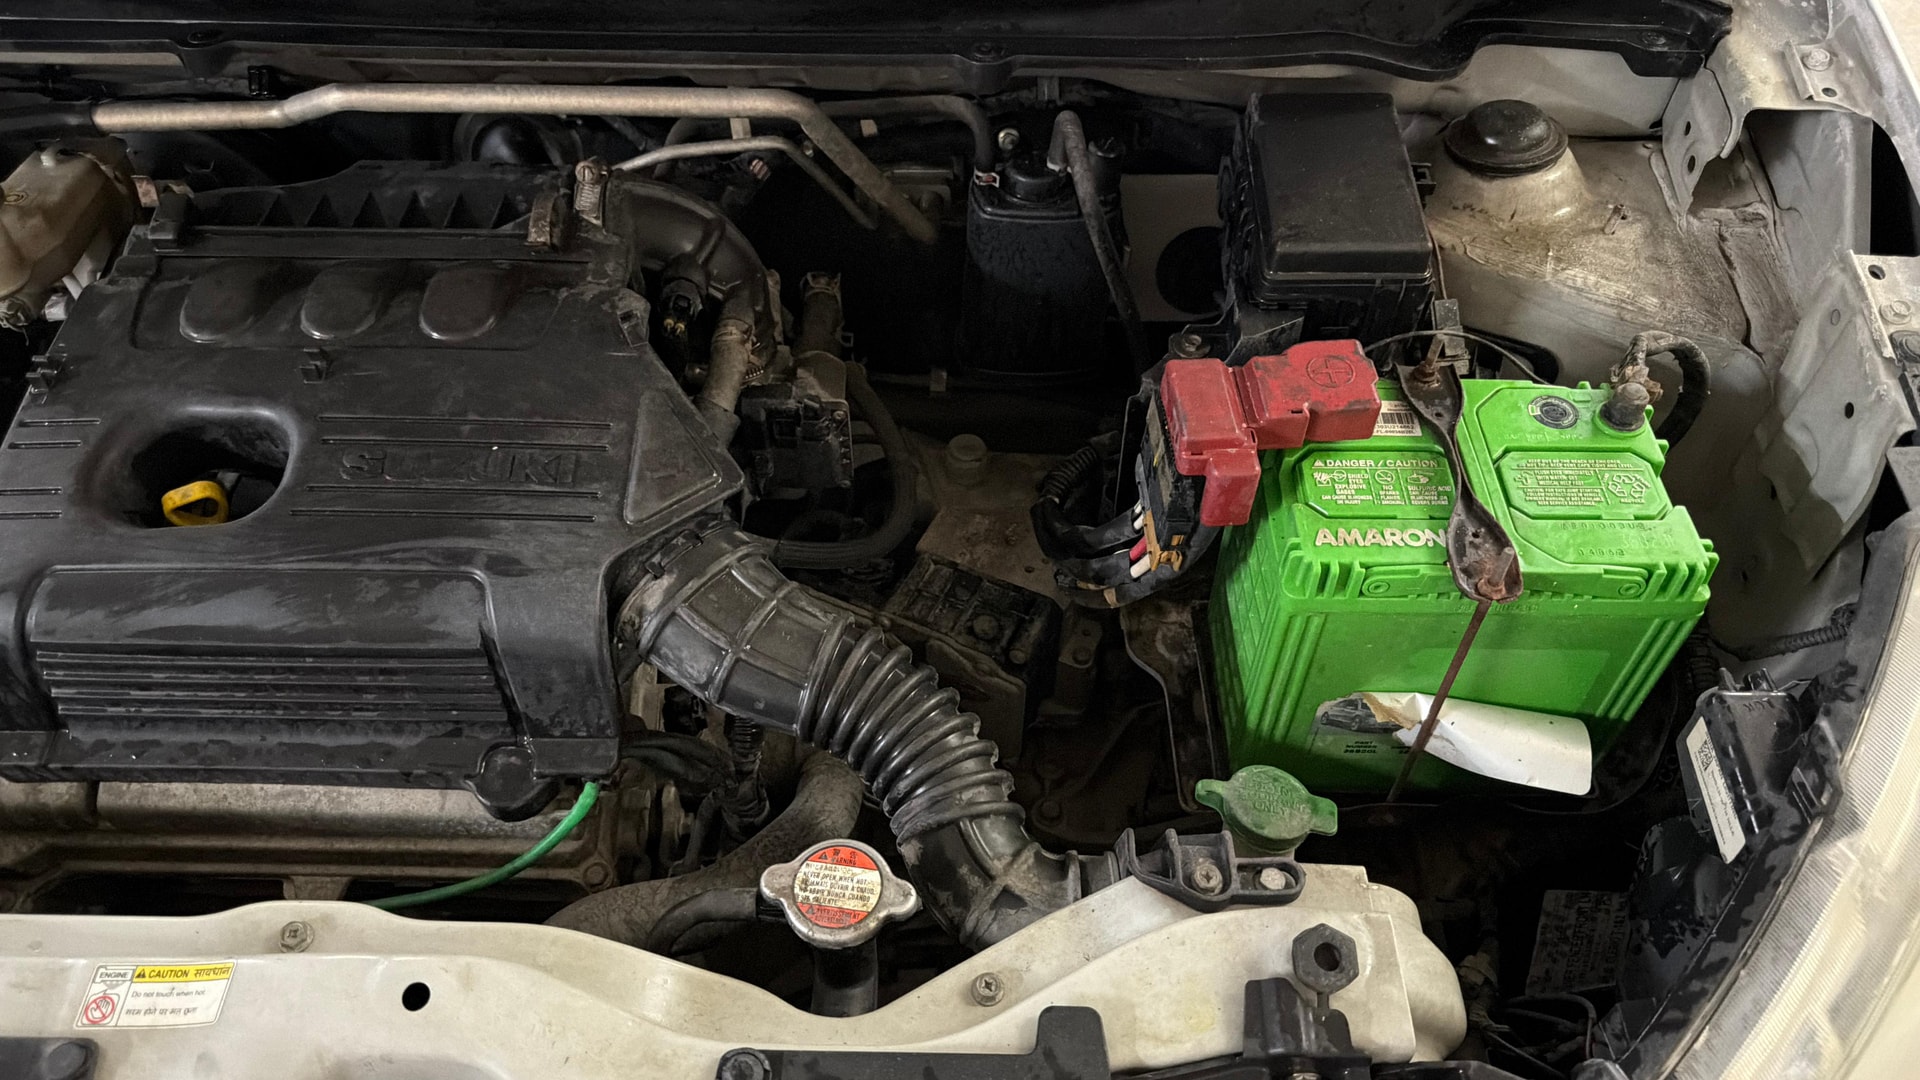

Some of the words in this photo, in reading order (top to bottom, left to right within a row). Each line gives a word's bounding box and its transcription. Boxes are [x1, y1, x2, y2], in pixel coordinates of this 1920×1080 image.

[1386, 460, 1438, 468] CAUTION
[1316, 528, 1446, 547] AMARON
[804, 872, 821, 880] NEVER
[822, 873, 838, 882] OPEN
[848, 894, 870, 903] CUANDO
[148, 970, 190, 979] CAUTION
[194, 966, 232, 978] सावधान
